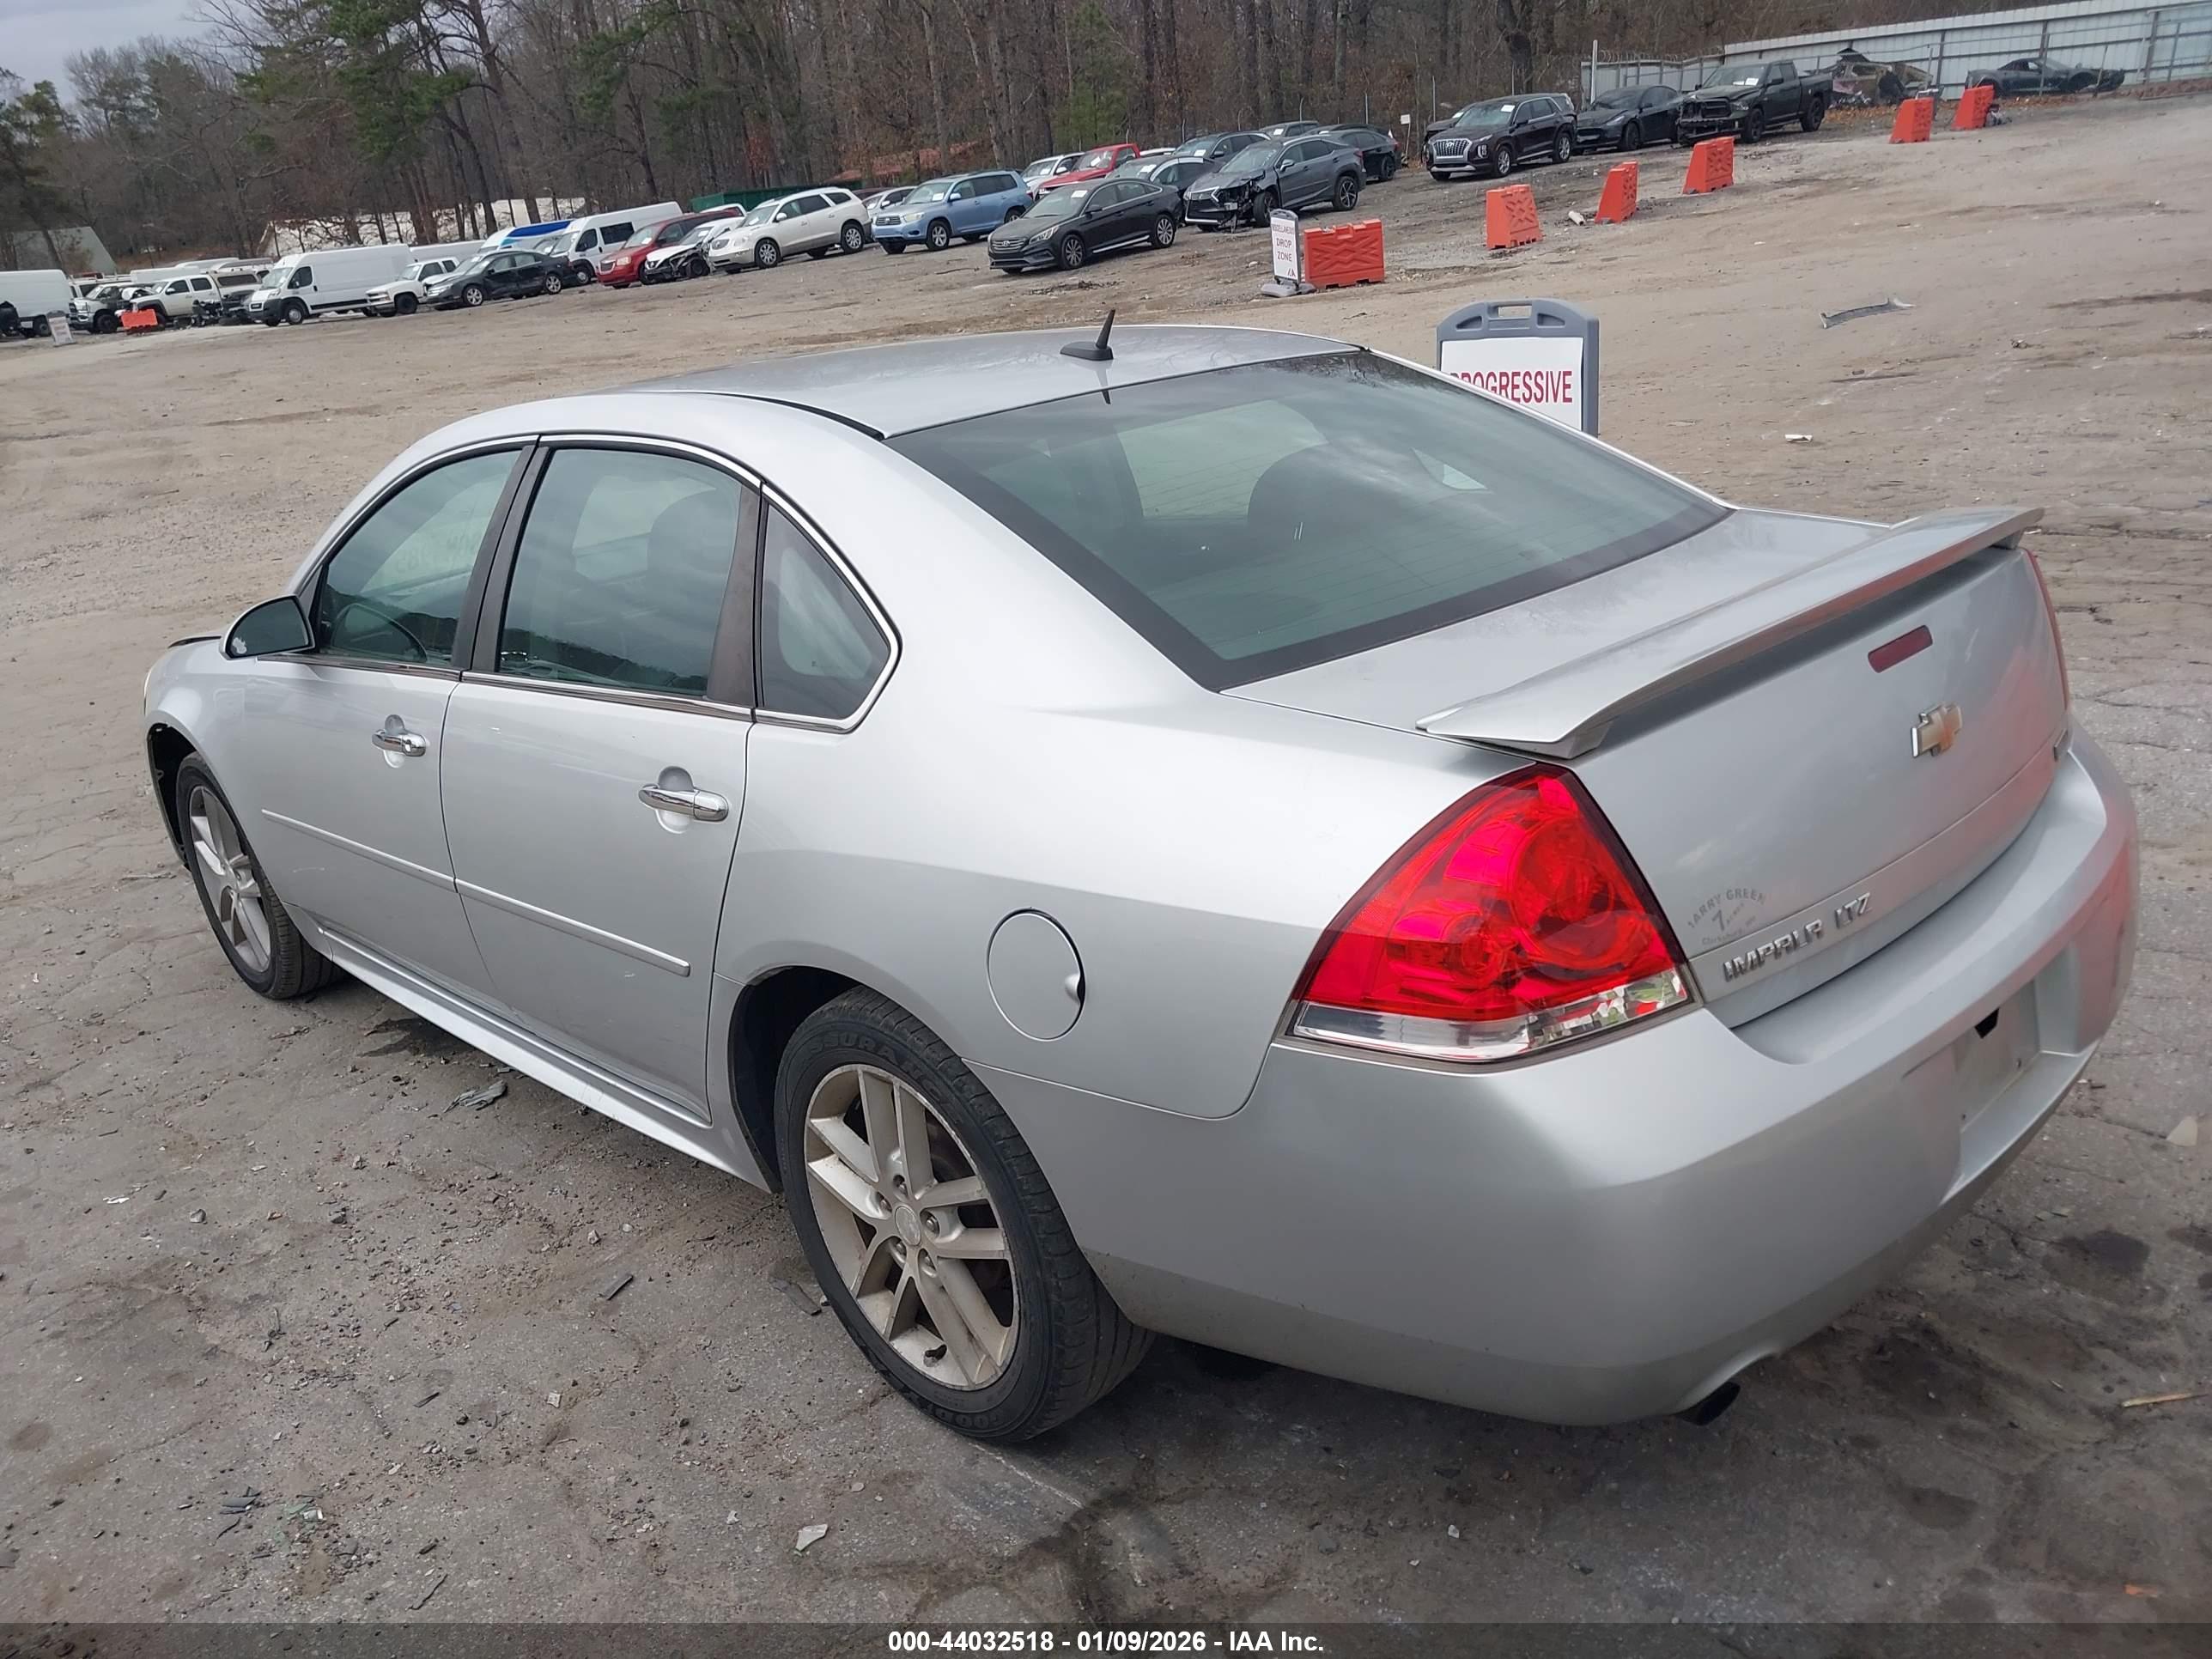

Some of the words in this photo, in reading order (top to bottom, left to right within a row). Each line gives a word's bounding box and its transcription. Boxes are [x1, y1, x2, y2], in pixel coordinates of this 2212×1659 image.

[1276, 237, 1292, 248] DROP
[1277, 251, 1292, 262] ZONE
[1450, 371, 1572, 404] GRESSIVE
[1726, 888, 1765, 906] GREEN
[1723, 919, 1823, 982] IMPALA
[1834, 891, 1872, 929] LTZ
